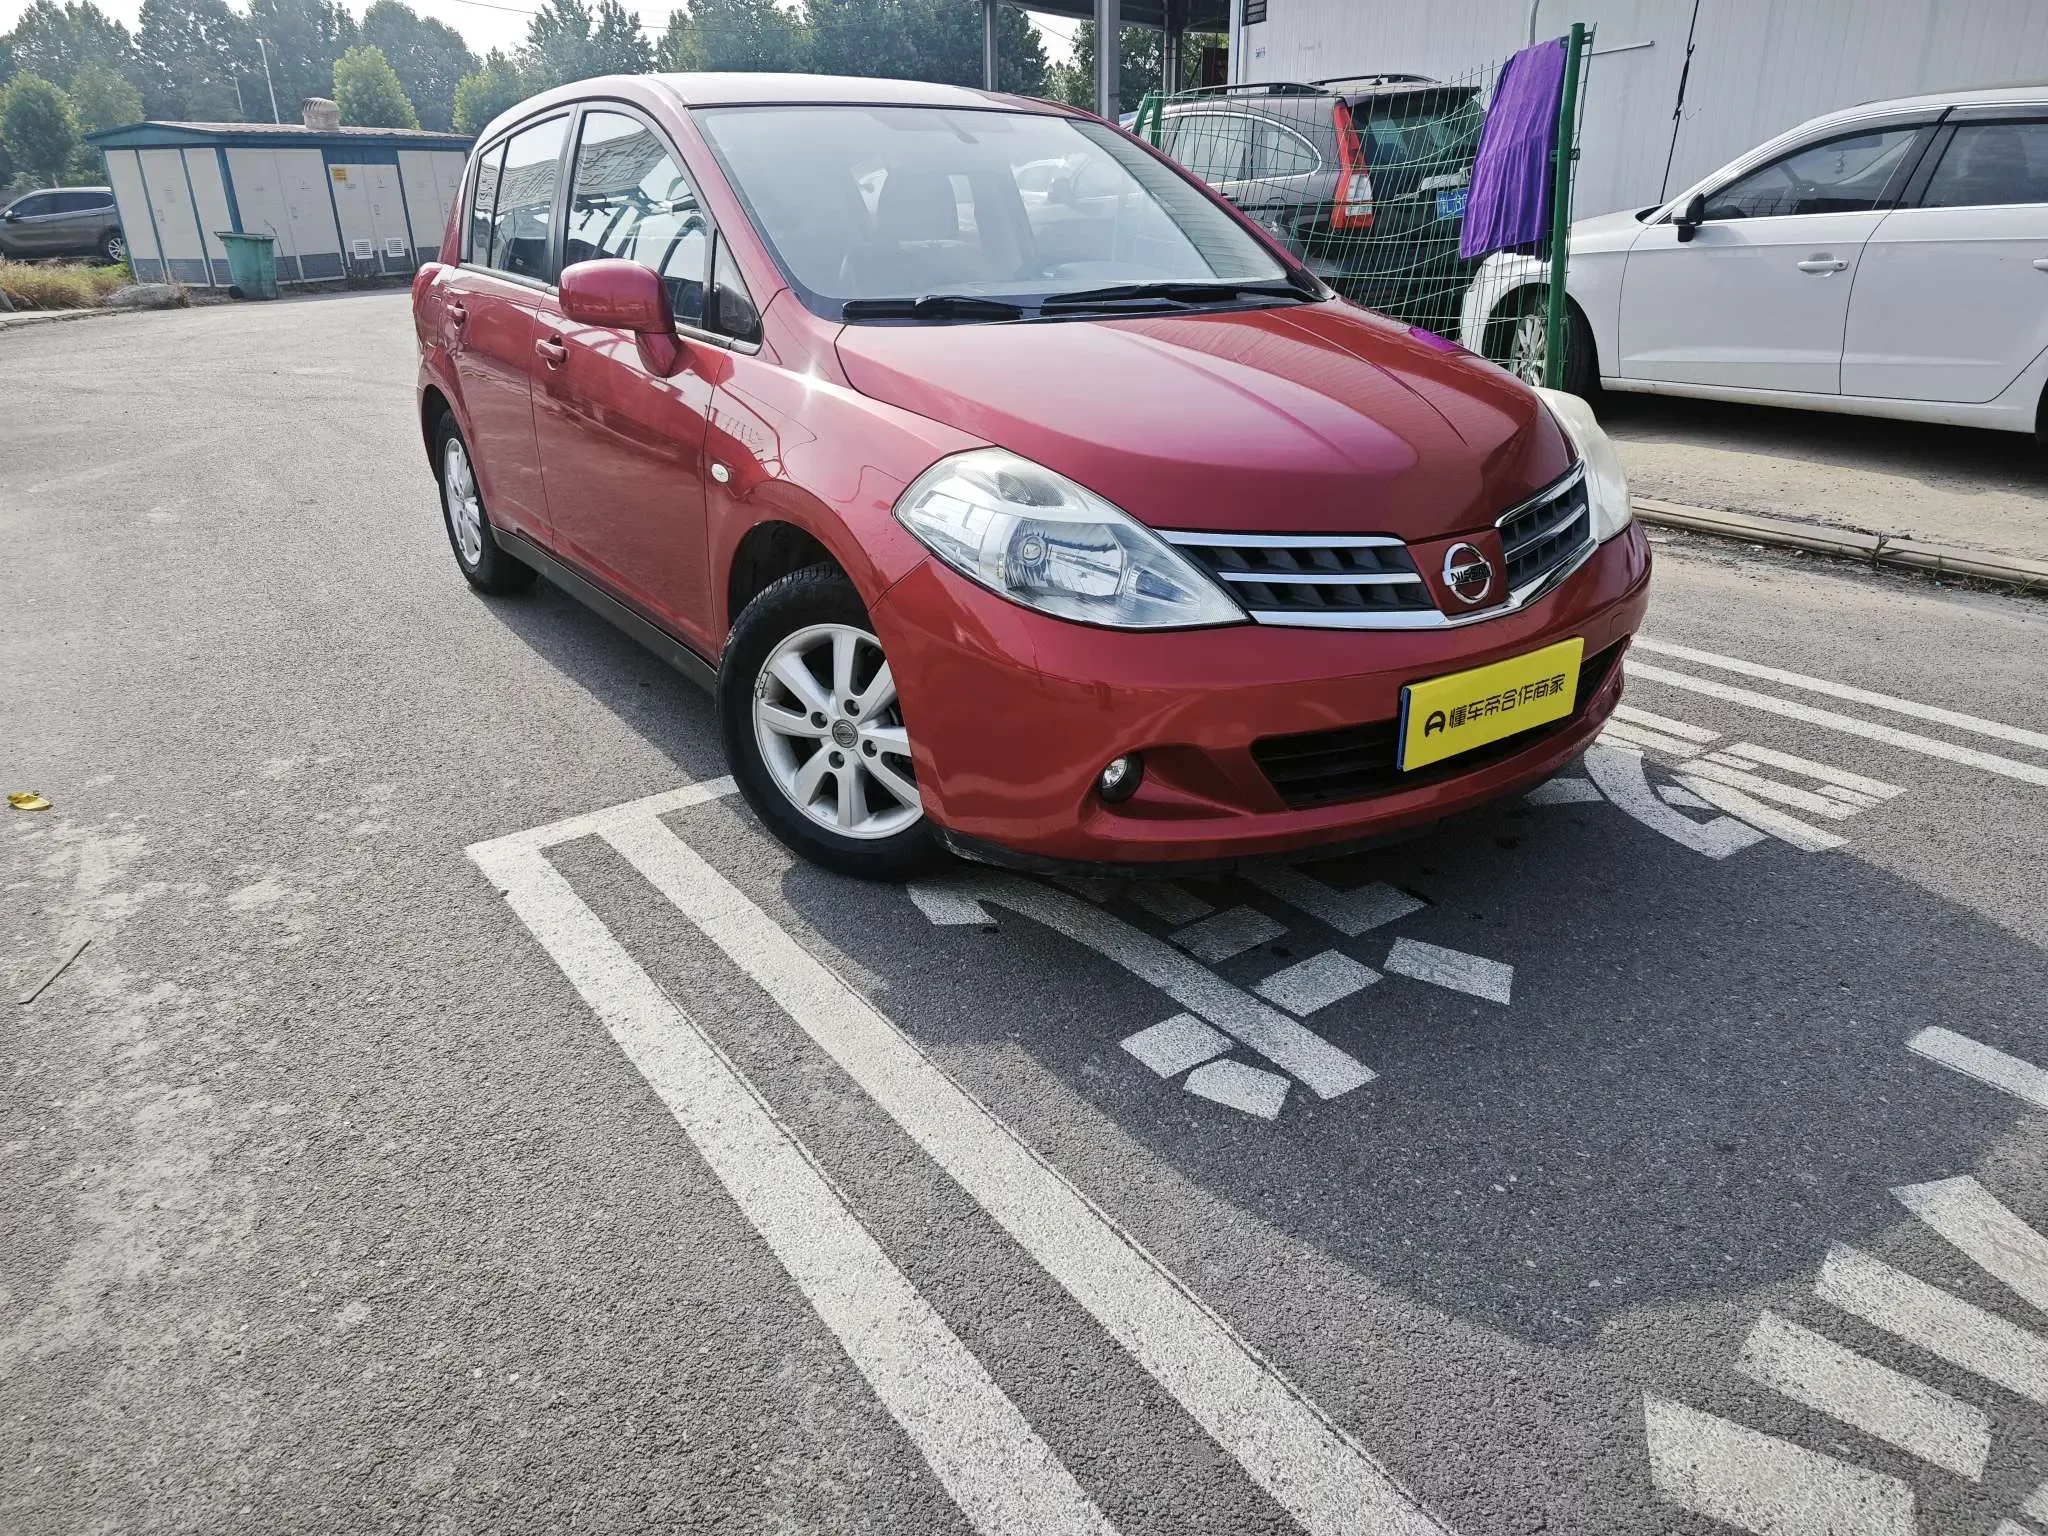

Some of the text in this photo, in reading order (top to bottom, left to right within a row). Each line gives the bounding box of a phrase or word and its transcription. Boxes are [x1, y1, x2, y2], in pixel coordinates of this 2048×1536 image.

[1450, 563, 1490, 583] NISSAN
[1449, 673, 1566, 728] 懂车帝合作商家
